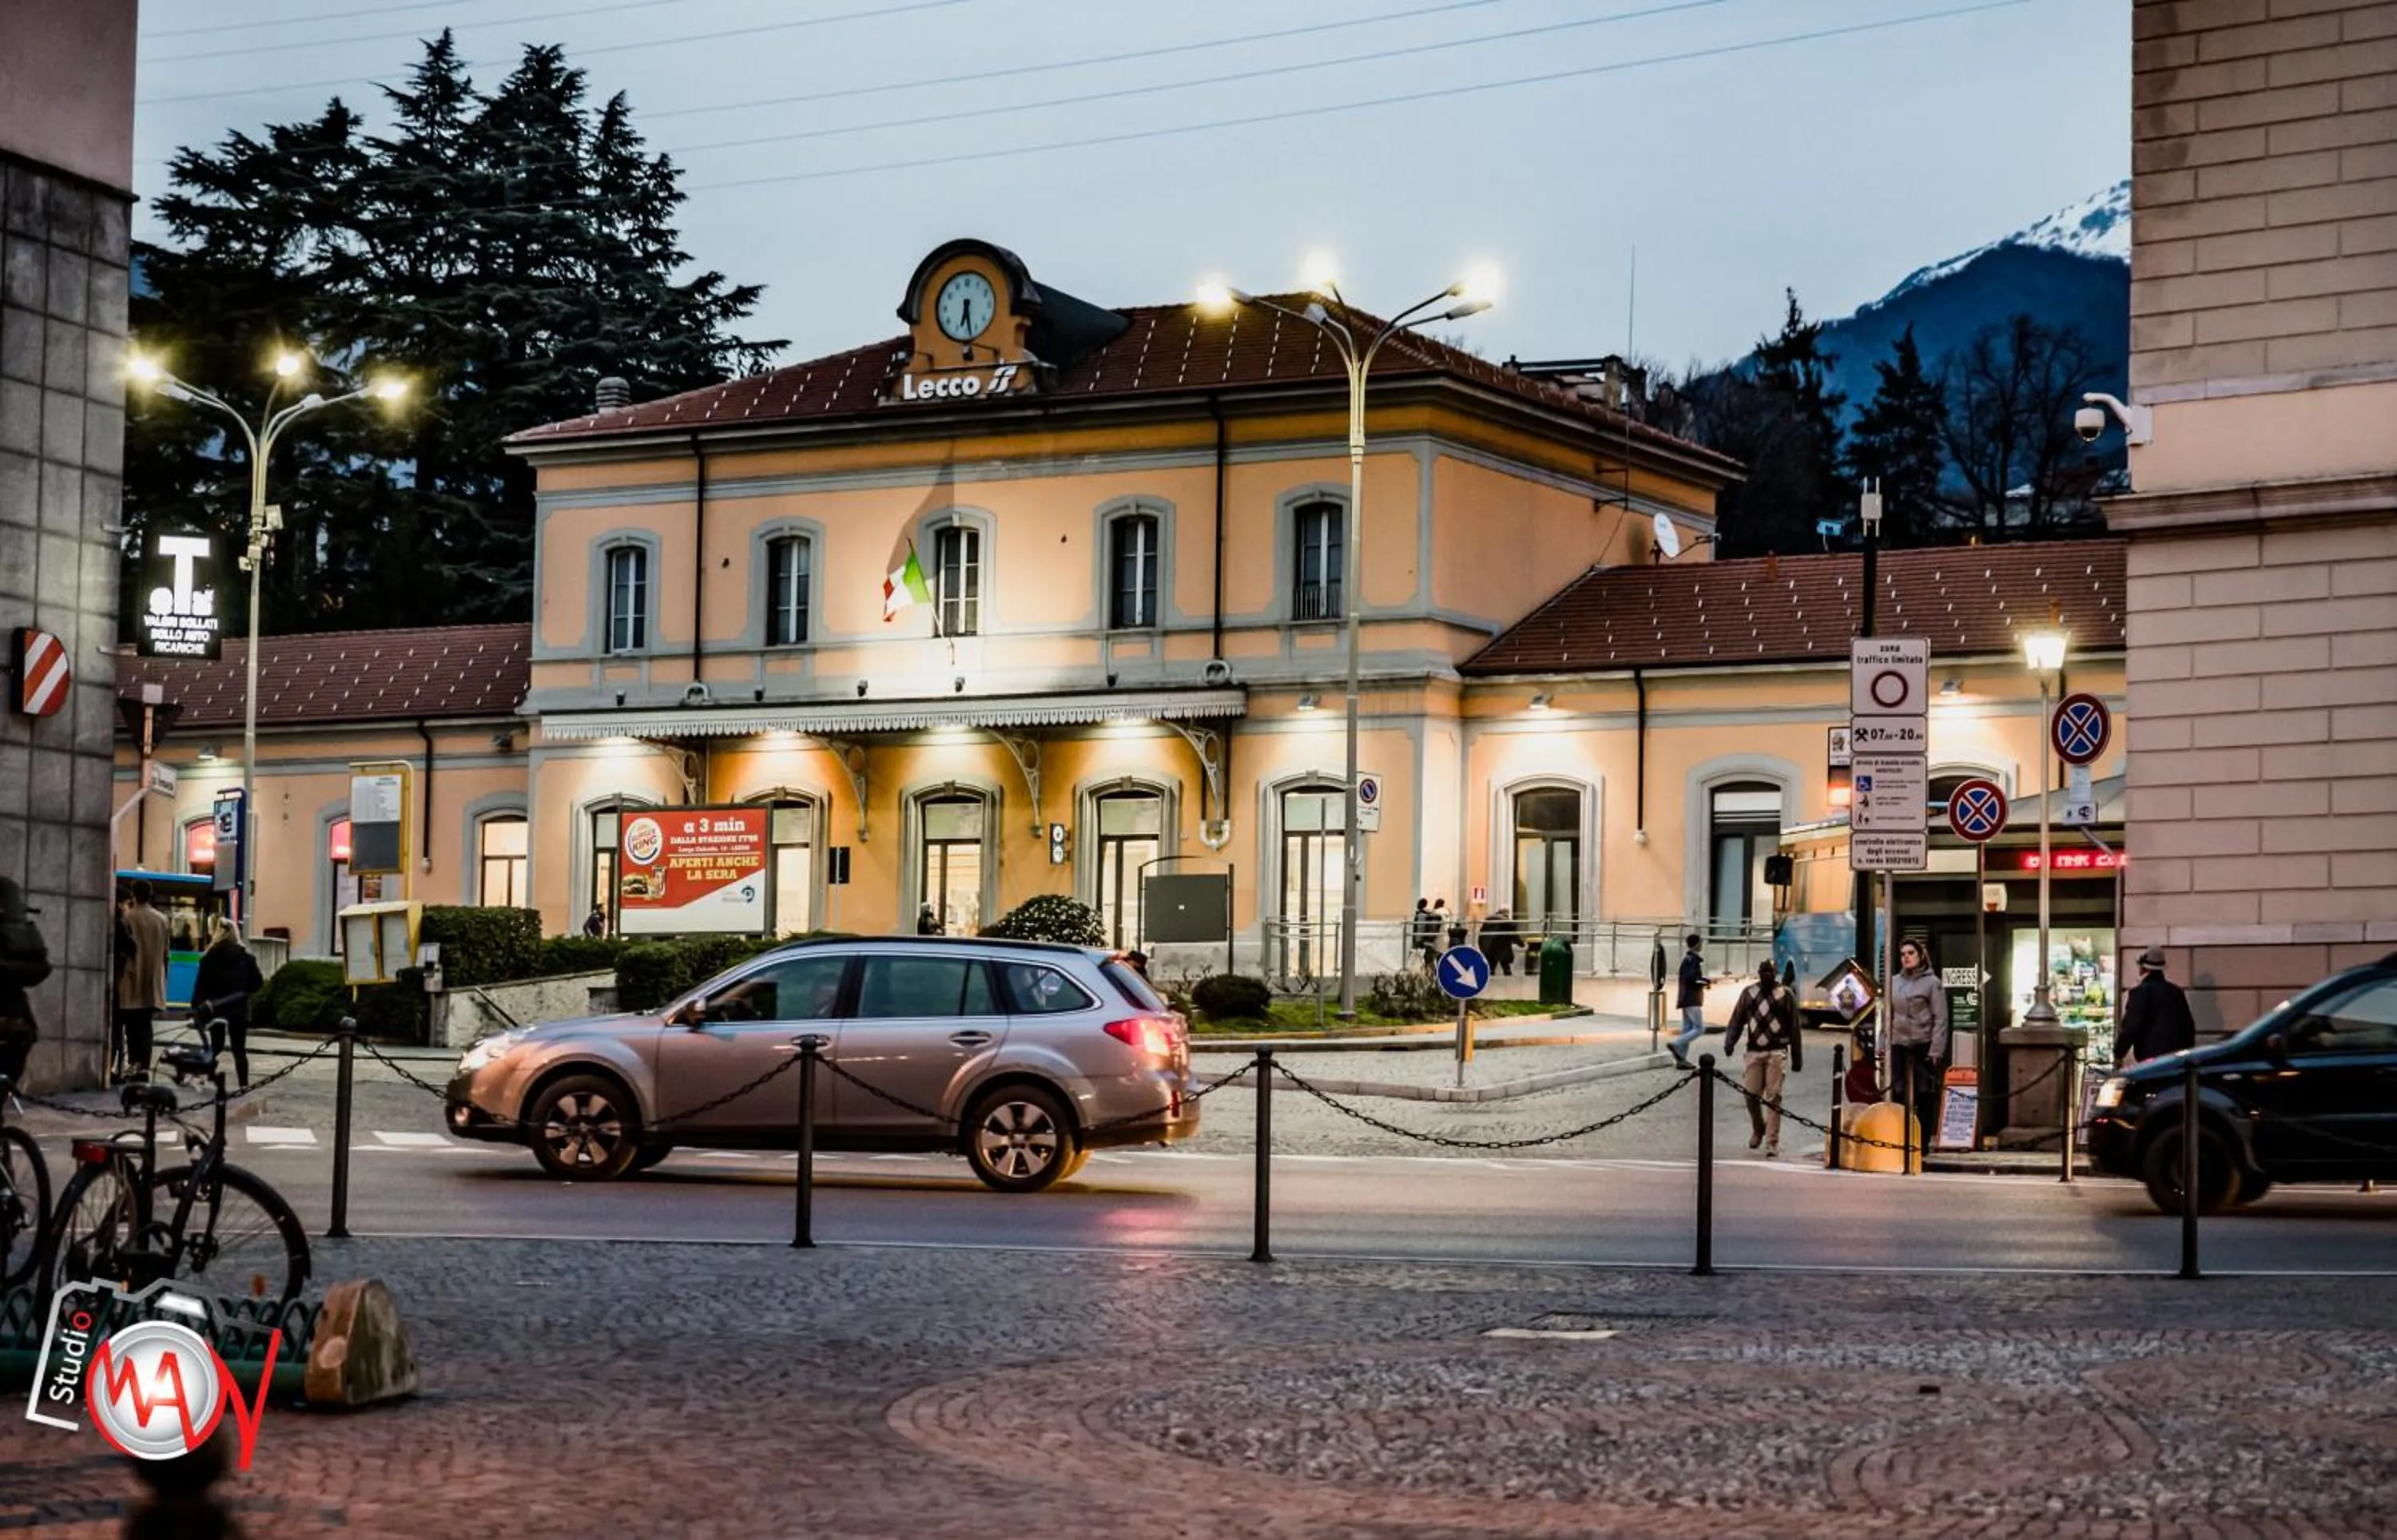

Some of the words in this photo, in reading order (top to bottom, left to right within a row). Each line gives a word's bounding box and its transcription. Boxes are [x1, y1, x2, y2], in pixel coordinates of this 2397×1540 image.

[903, 373, 981, 399] Lecco
[179, 617, 218, 629] BOLLATI
[150, 628, 182, 640] BOLLO
[184, 630, 209, 641] AUTO
[154, 641, 205, 654] RICARICHE
[1857, 655, 1890, 664] traffico
[699, 818, 709, 832] 3
[714, 816, 745, 832] min
[632, 835, 658, 852] KING
[669, 857, 713, 868] APERTI
[716, 855, 759, 867] ANCHE
[686, 870, 702, 880] LA
[706, 869, 737, 879] SERA
[1943, 969, 1976, 985] INGRESS
